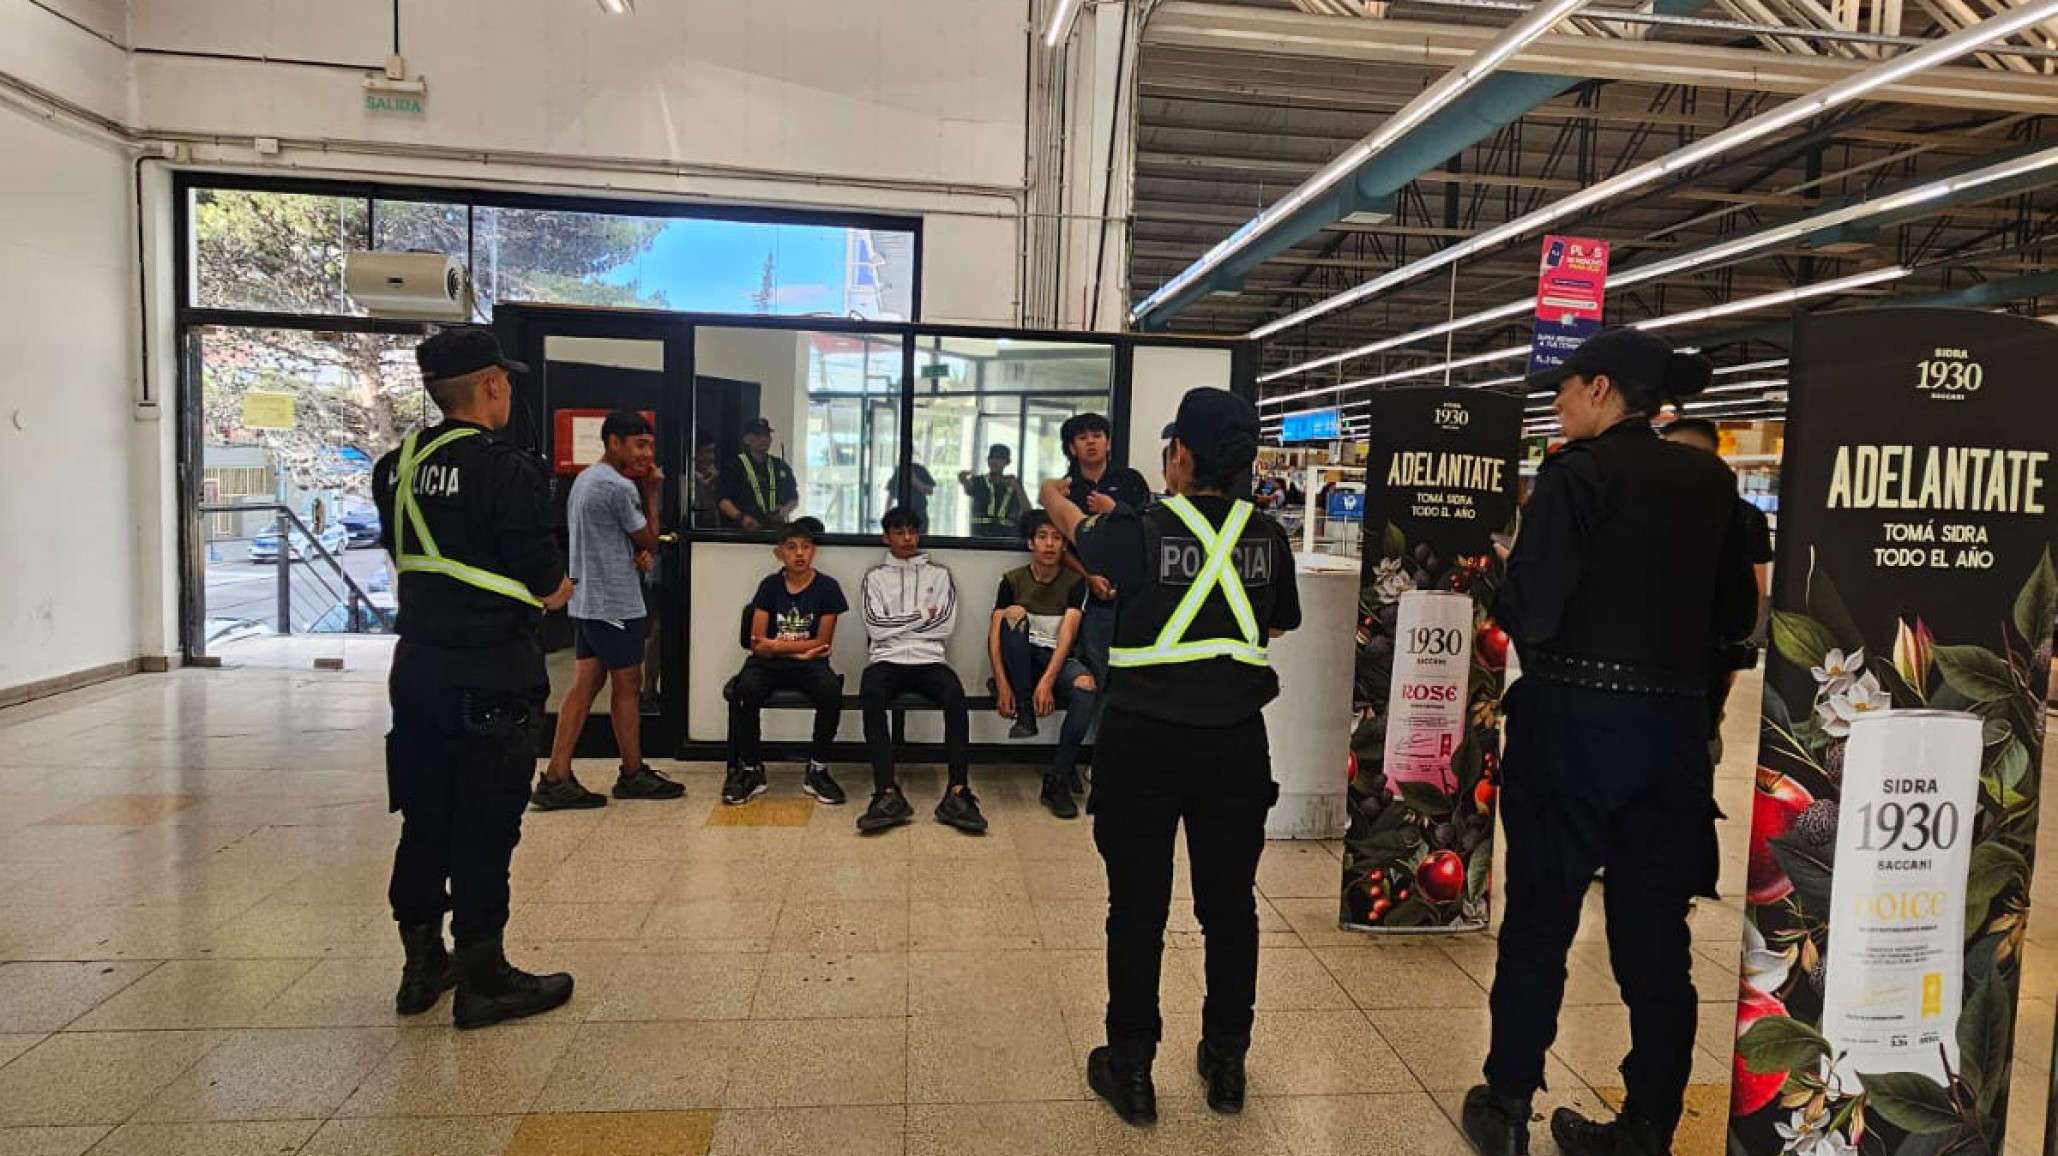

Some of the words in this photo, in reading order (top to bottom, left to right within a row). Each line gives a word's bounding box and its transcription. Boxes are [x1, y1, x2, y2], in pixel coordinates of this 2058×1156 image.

[366, 96, 422, 113] SALIDA
[1915, 360, 1983, 391] 1930
[1433, 407, 1469, 425] 1930
[388, 464, 459, 496] PLICIA
[1387, 452, 1505, 493] ADELANTATE
[1825, 445, 2049, 514] ADELANTATE
[1410, 505, 1440, 517] TODO
[1883, 518, 1935, 542] TOMÁ
[1941, 524, 1988, 543] SIDRA
[1163, 545, 1267, 579] POIA
[1873, 548, 1926, 567] TODO
[1931, 549, 1949, 568] EL
[1955, 547, 1994, 569] AÑO
[1406, 626, 1463, 656] 1930
[1882, 779, 1938, 794] SIDRA
[1855, 801, 1959, 851] 1930
